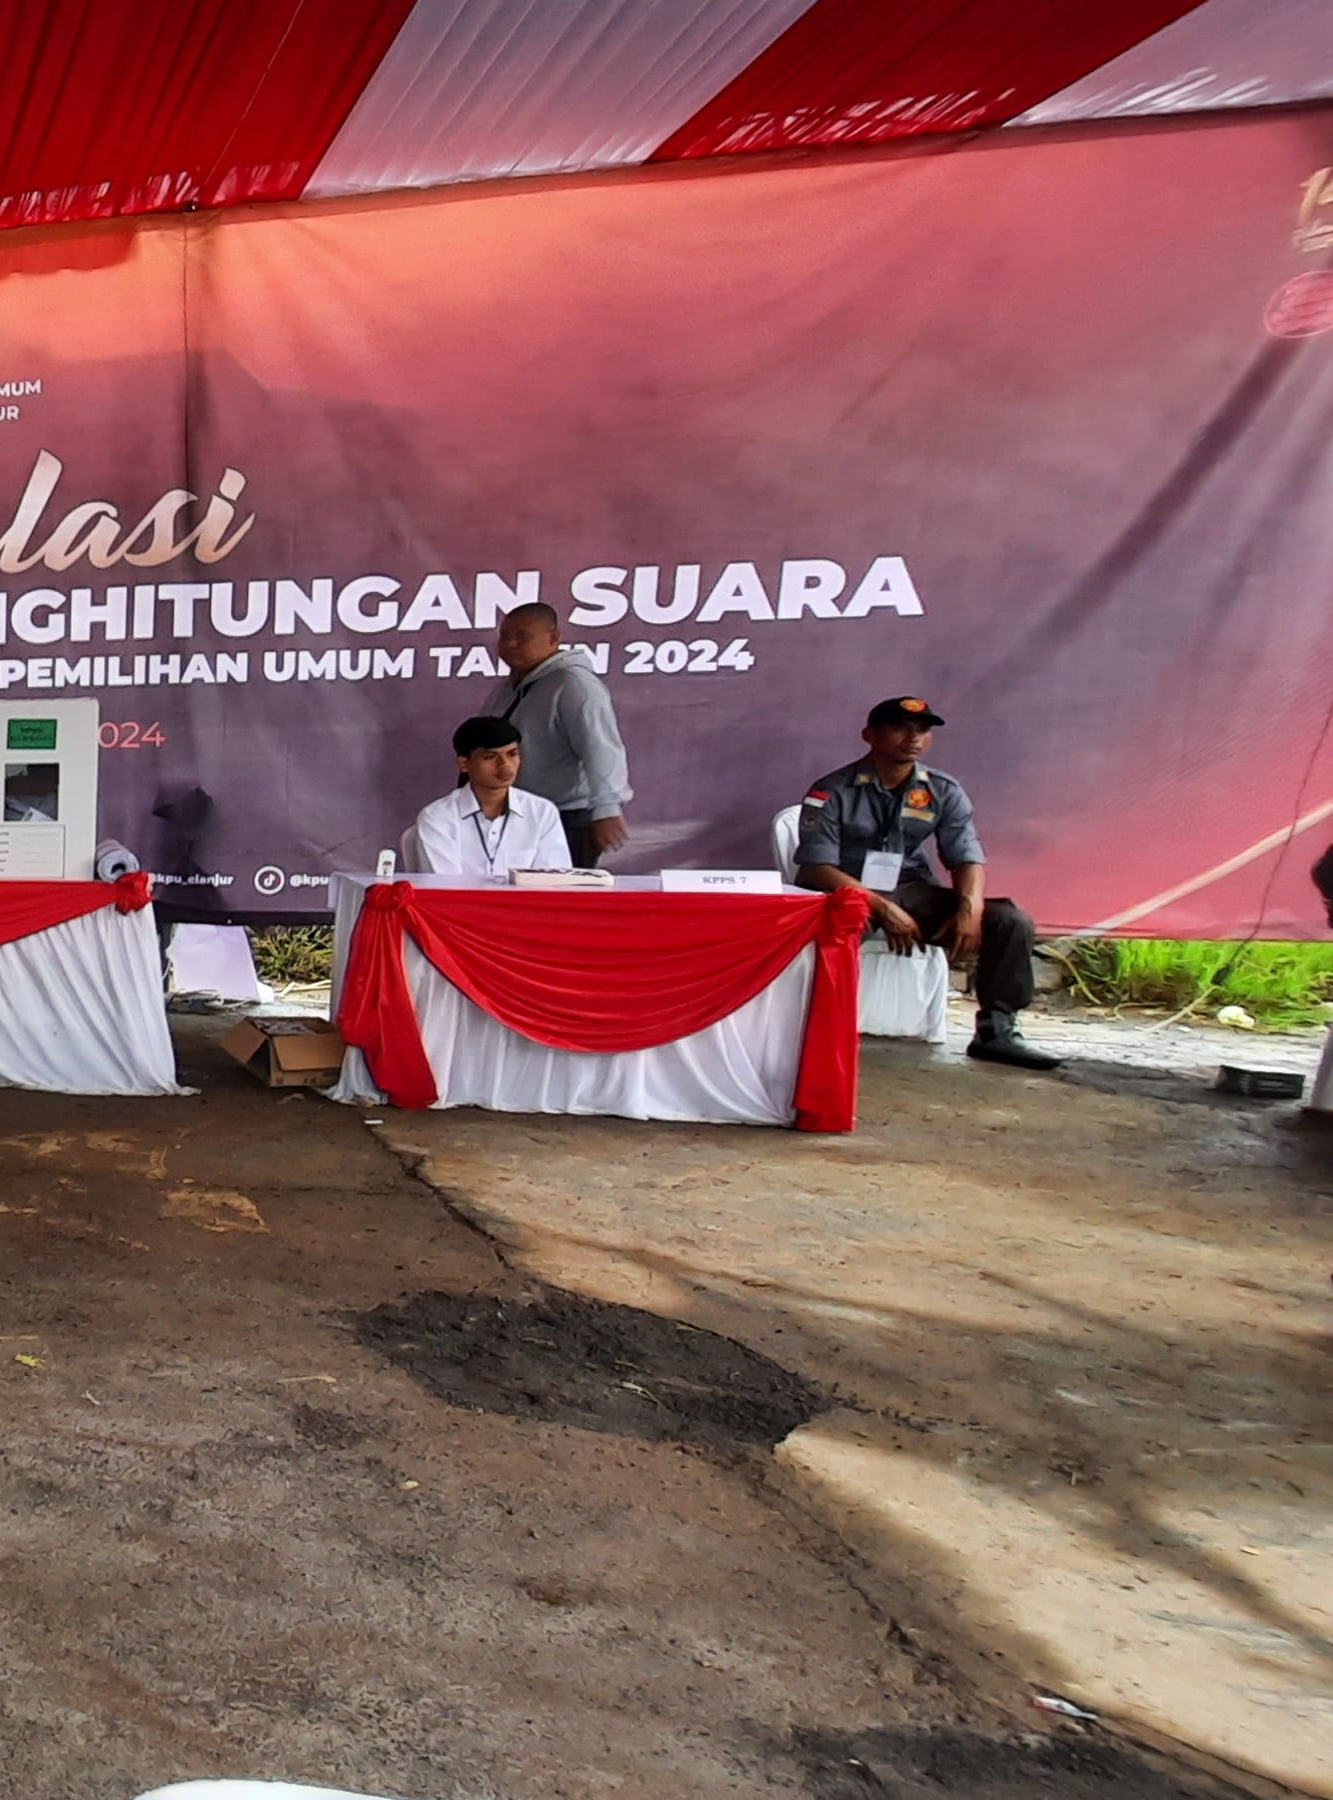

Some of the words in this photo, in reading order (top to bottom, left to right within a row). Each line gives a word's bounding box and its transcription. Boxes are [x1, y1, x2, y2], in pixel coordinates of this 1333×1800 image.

[567, 555, 925, 627] SUARA
[262, 647, 416, 683] UMUM
[429, 643, 610, 678] TAN
[623, 638, 756, 675] 2024
[97, 721, 166, 749] 024
